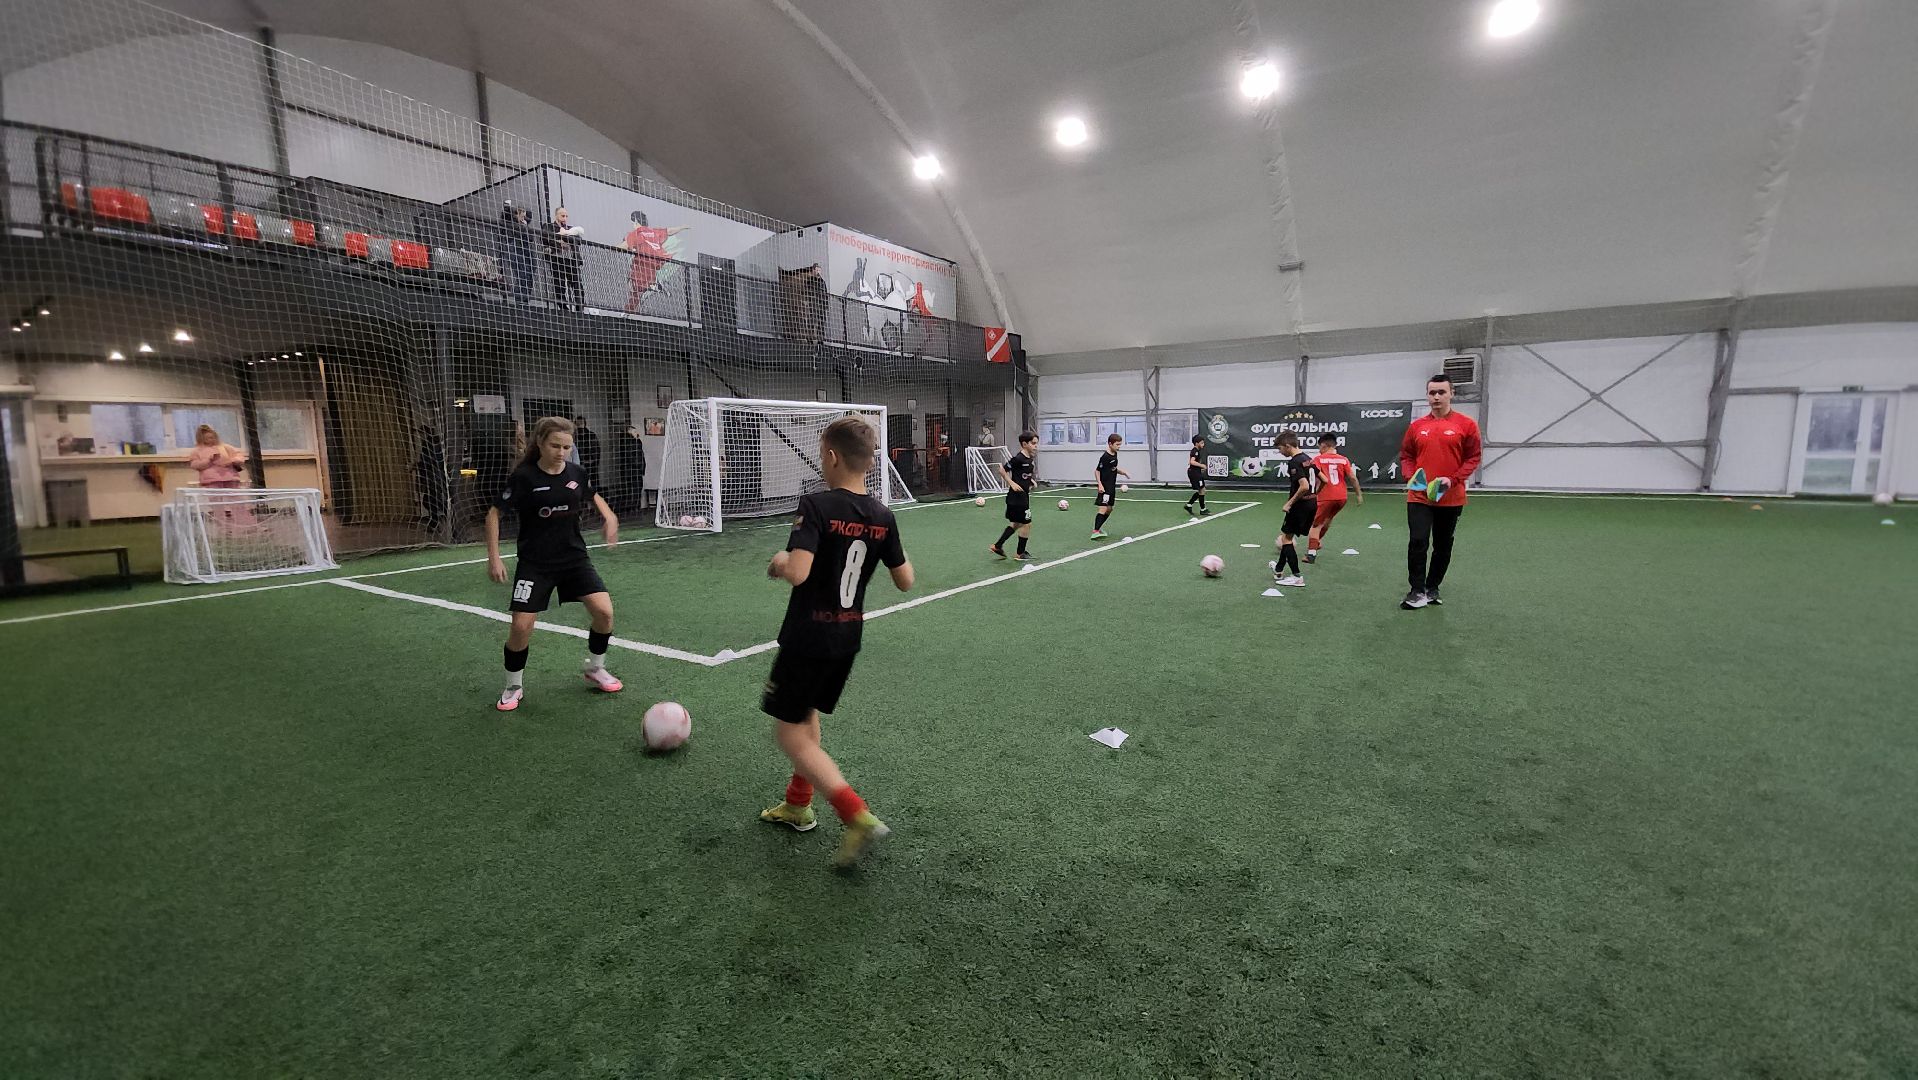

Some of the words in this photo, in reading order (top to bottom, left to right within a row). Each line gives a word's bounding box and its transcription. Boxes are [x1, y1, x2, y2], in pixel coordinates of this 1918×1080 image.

[1251, 422, 1348, 433] ФУТБОЛЬНАЯ
[1252, 437, 1345, 447] ТЕРТОЯ
[839, 539, 868, 609] 8
